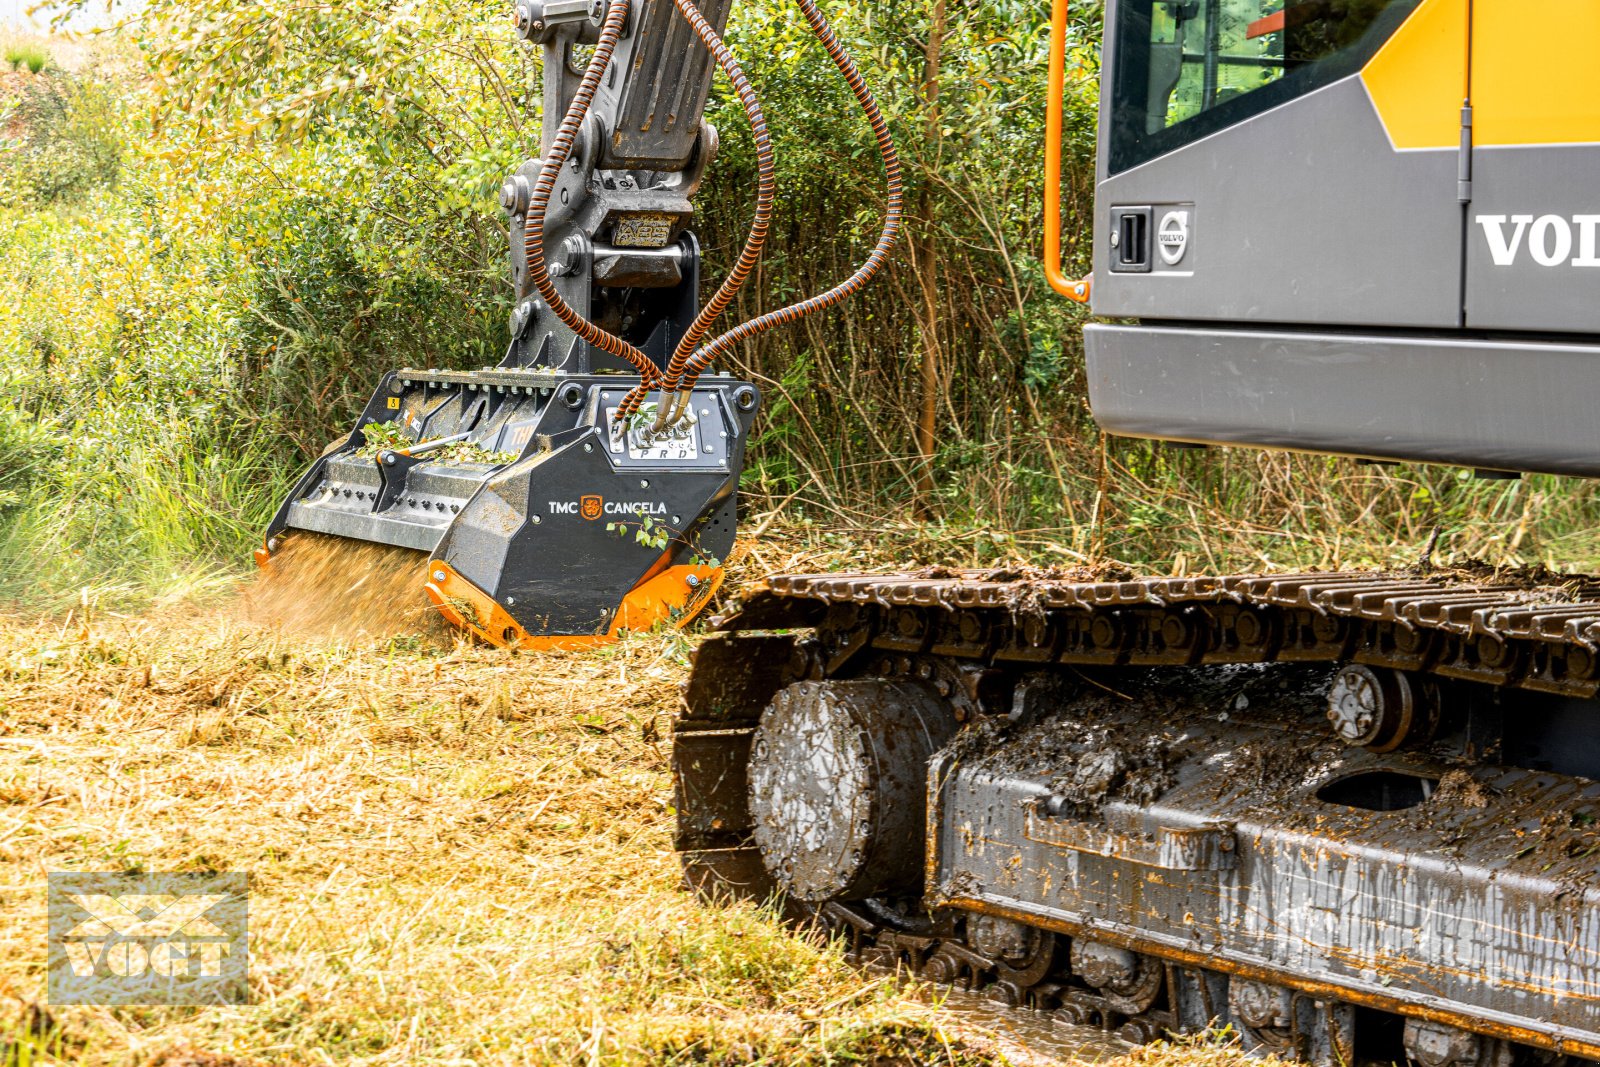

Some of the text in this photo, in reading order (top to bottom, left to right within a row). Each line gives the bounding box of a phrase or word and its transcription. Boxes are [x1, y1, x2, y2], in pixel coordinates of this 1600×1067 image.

[1160, 234, 1185, 242] VOLVO
[640, 449, 688, 459] P R D
[548, 501, 667, 514] TMC CANCELA
